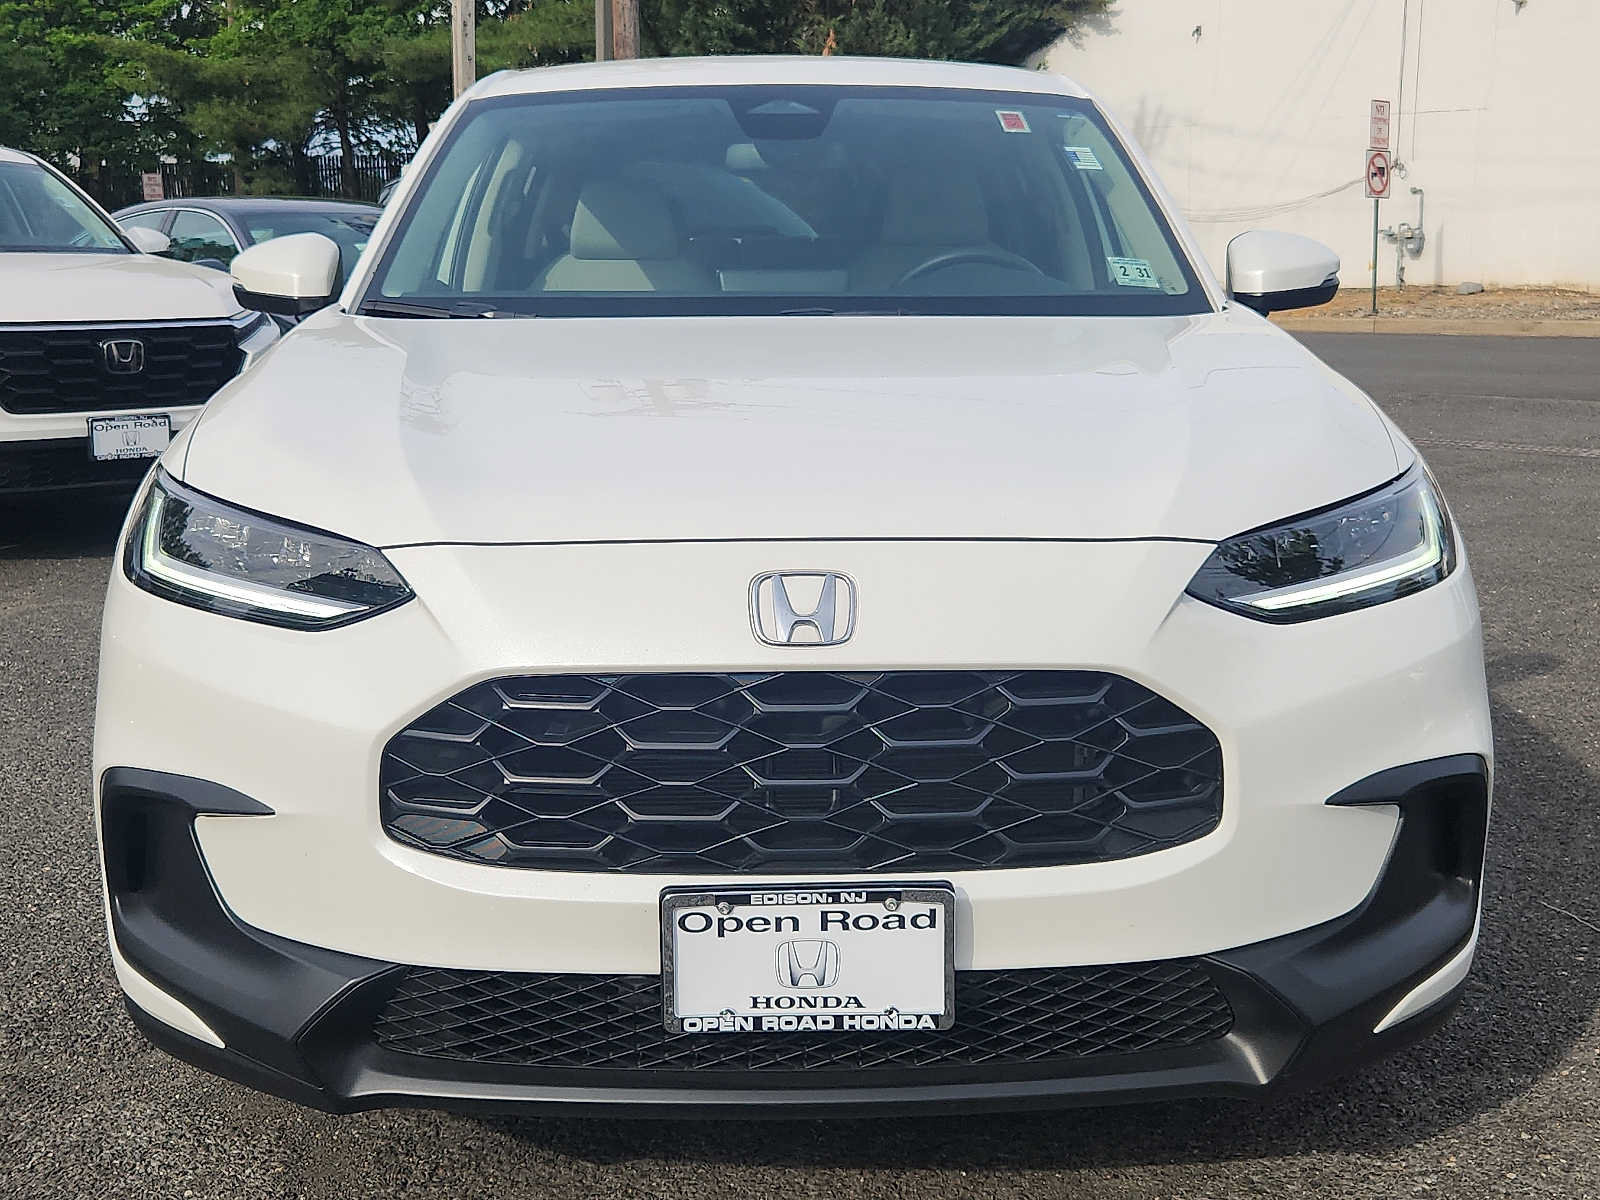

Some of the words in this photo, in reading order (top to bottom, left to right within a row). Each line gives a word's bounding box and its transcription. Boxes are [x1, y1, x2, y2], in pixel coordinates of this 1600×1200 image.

[1120, 265, 1130, 276] 2
[1136, 267, 1151, 278] 31
[94, 424, 129, 432] Open
[134, 420, 167, 429] Road
[840, 892, 867, 904] NJ
[678, 911, 800, 938] Open
[820, 908, 937, 932] Road
[750, 995, 866, 1009] HONDA
[683, 1016, 753, 1032] OPEN
[762, 1016, 835, 1031] ROAD
[843, 1014, 936, 1031] HONDA
